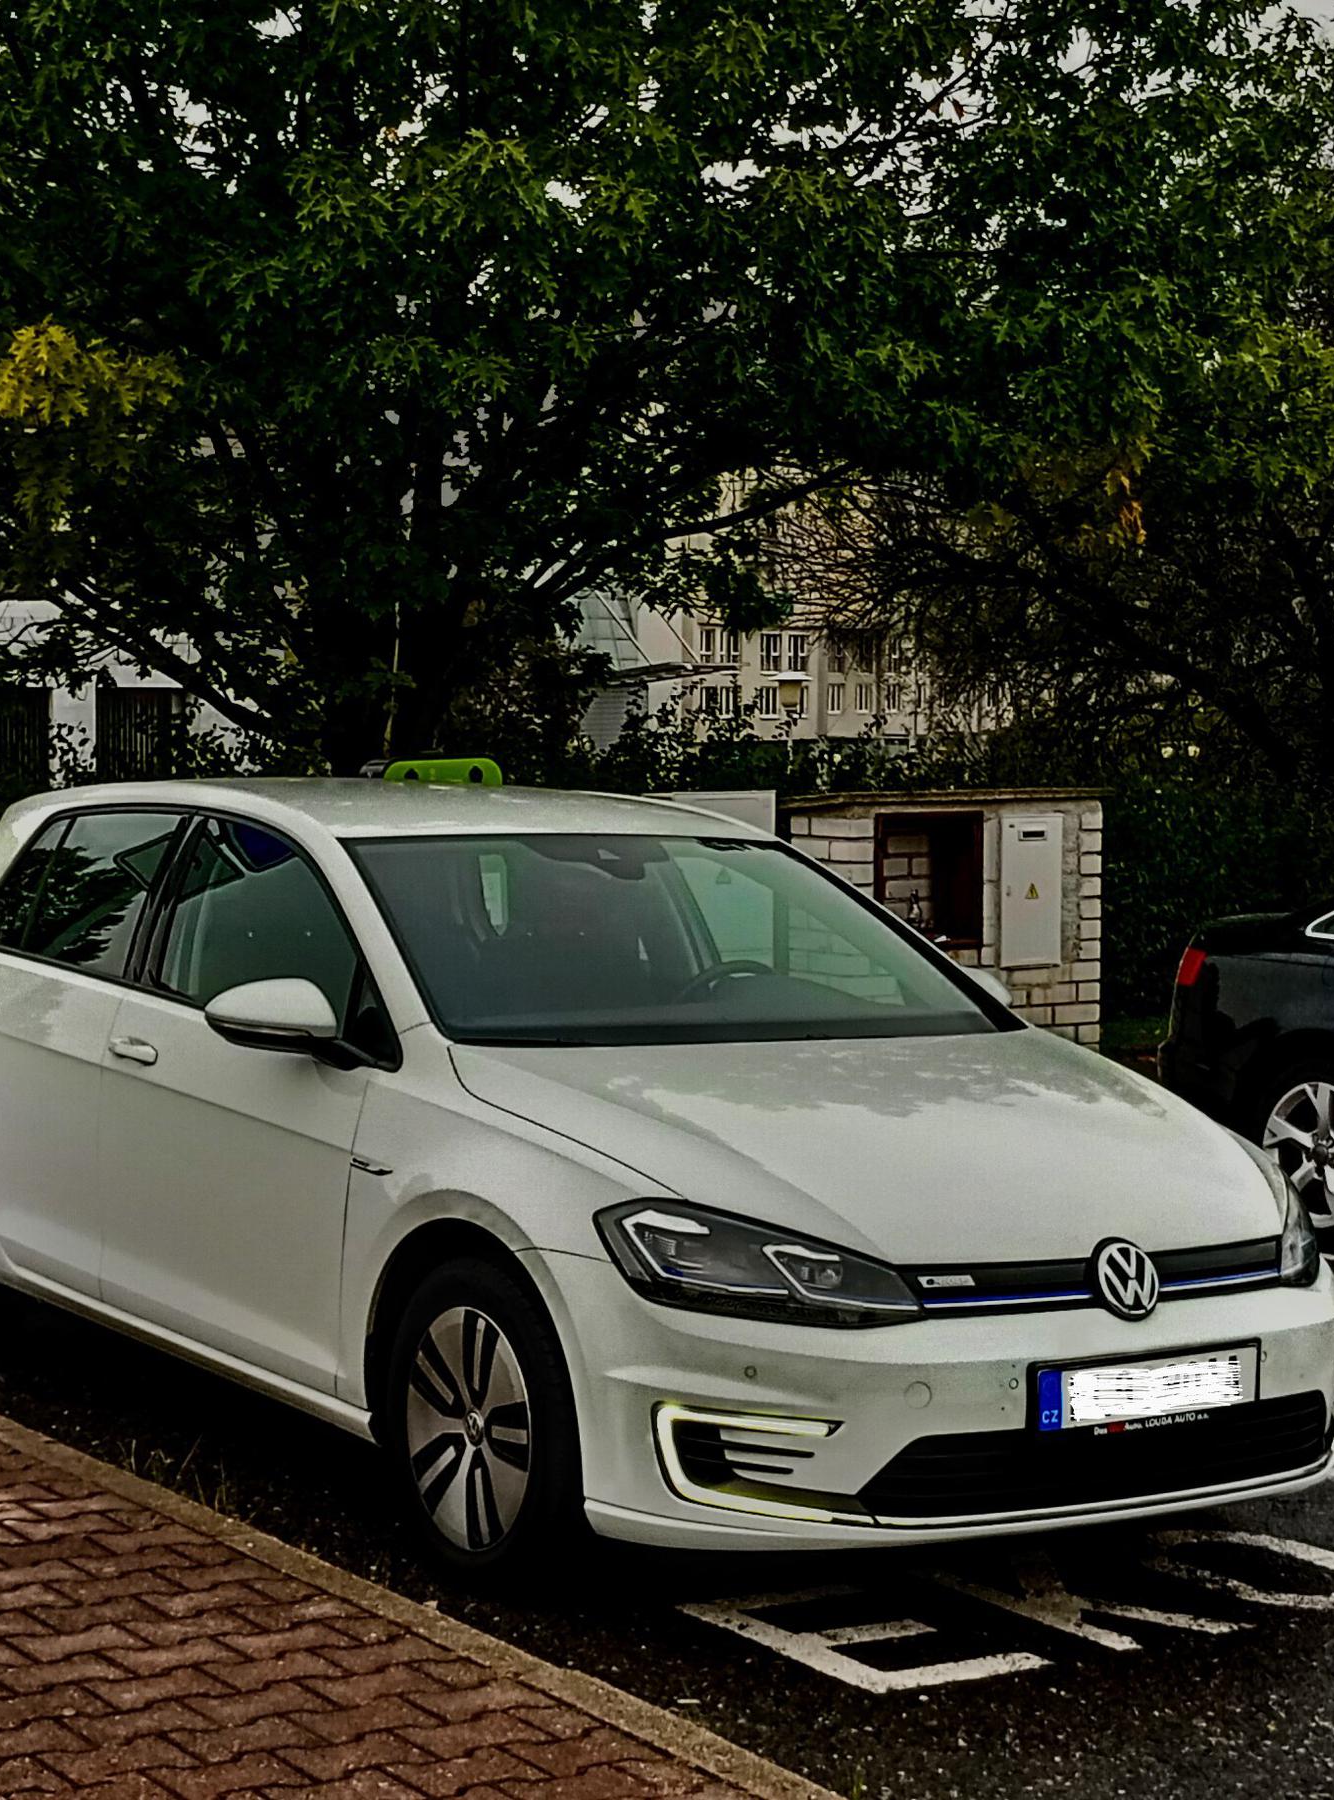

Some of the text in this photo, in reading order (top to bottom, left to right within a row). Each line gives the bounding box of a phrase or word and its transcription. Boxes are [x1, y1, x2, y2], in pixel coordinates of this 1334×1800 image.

[1041, 1410, 1058, 1424] CZ
[1145, 1416, 1172, 1428] LOUDA
[1174, 1412, 1196, 1423] AUTO
